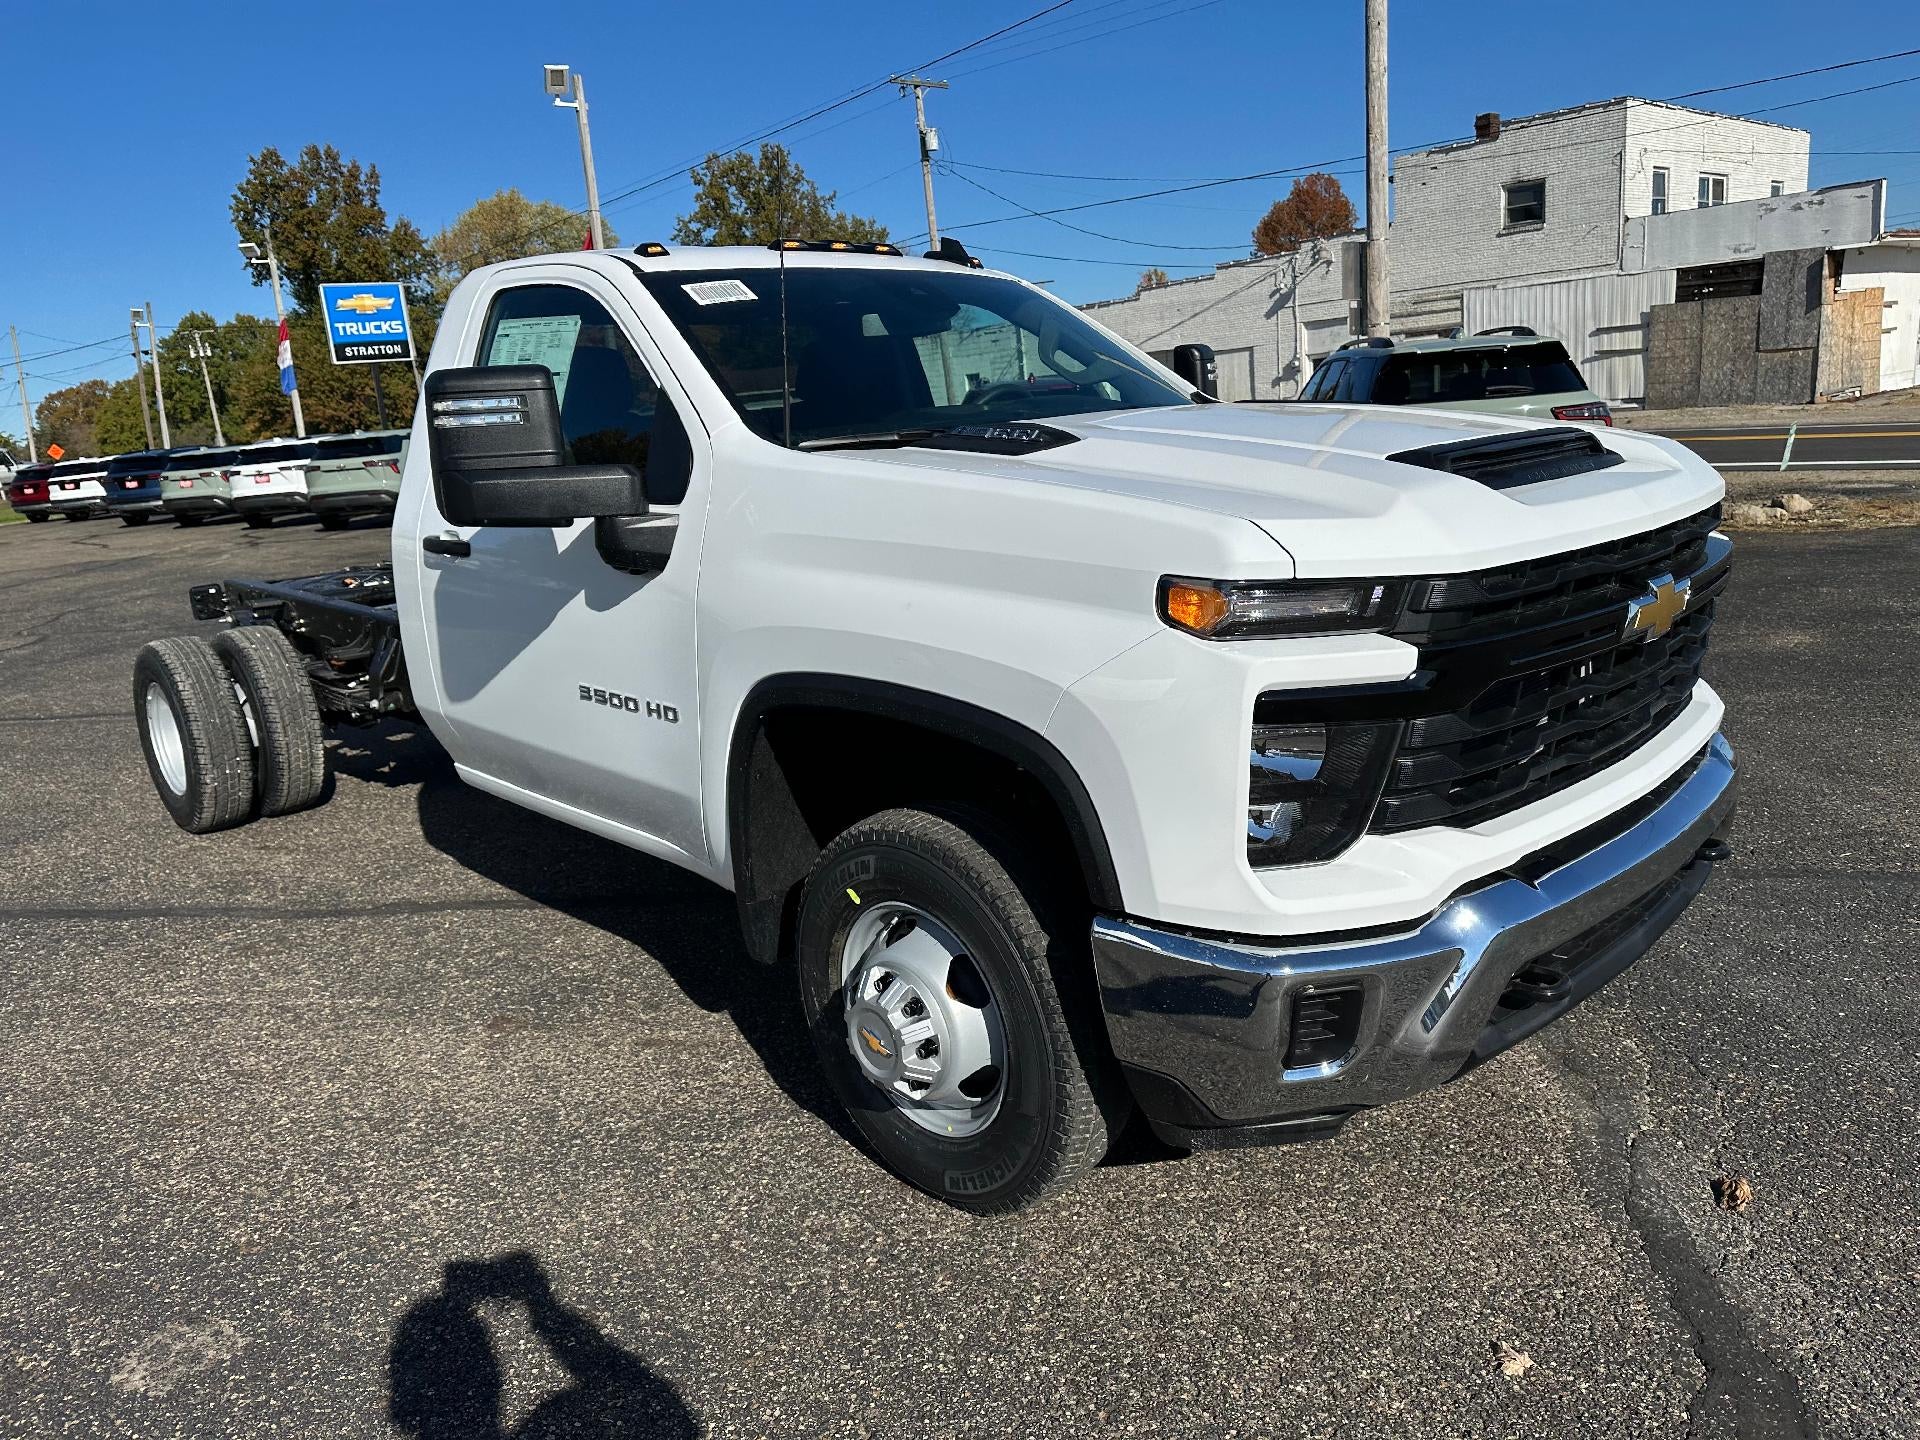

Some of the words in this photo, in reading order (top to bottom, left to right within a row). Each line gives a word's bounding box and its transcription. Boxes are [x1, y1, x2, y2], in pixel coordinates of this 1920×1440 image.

[334, 321, 404, 336] TRUCKS
[344, 344, 402, 357] STRATTON
[579, 684, 640, 714] 3500
[646, 700, 680, 724] HD
[948, 1147, 1021, 1191] MICHELIN
